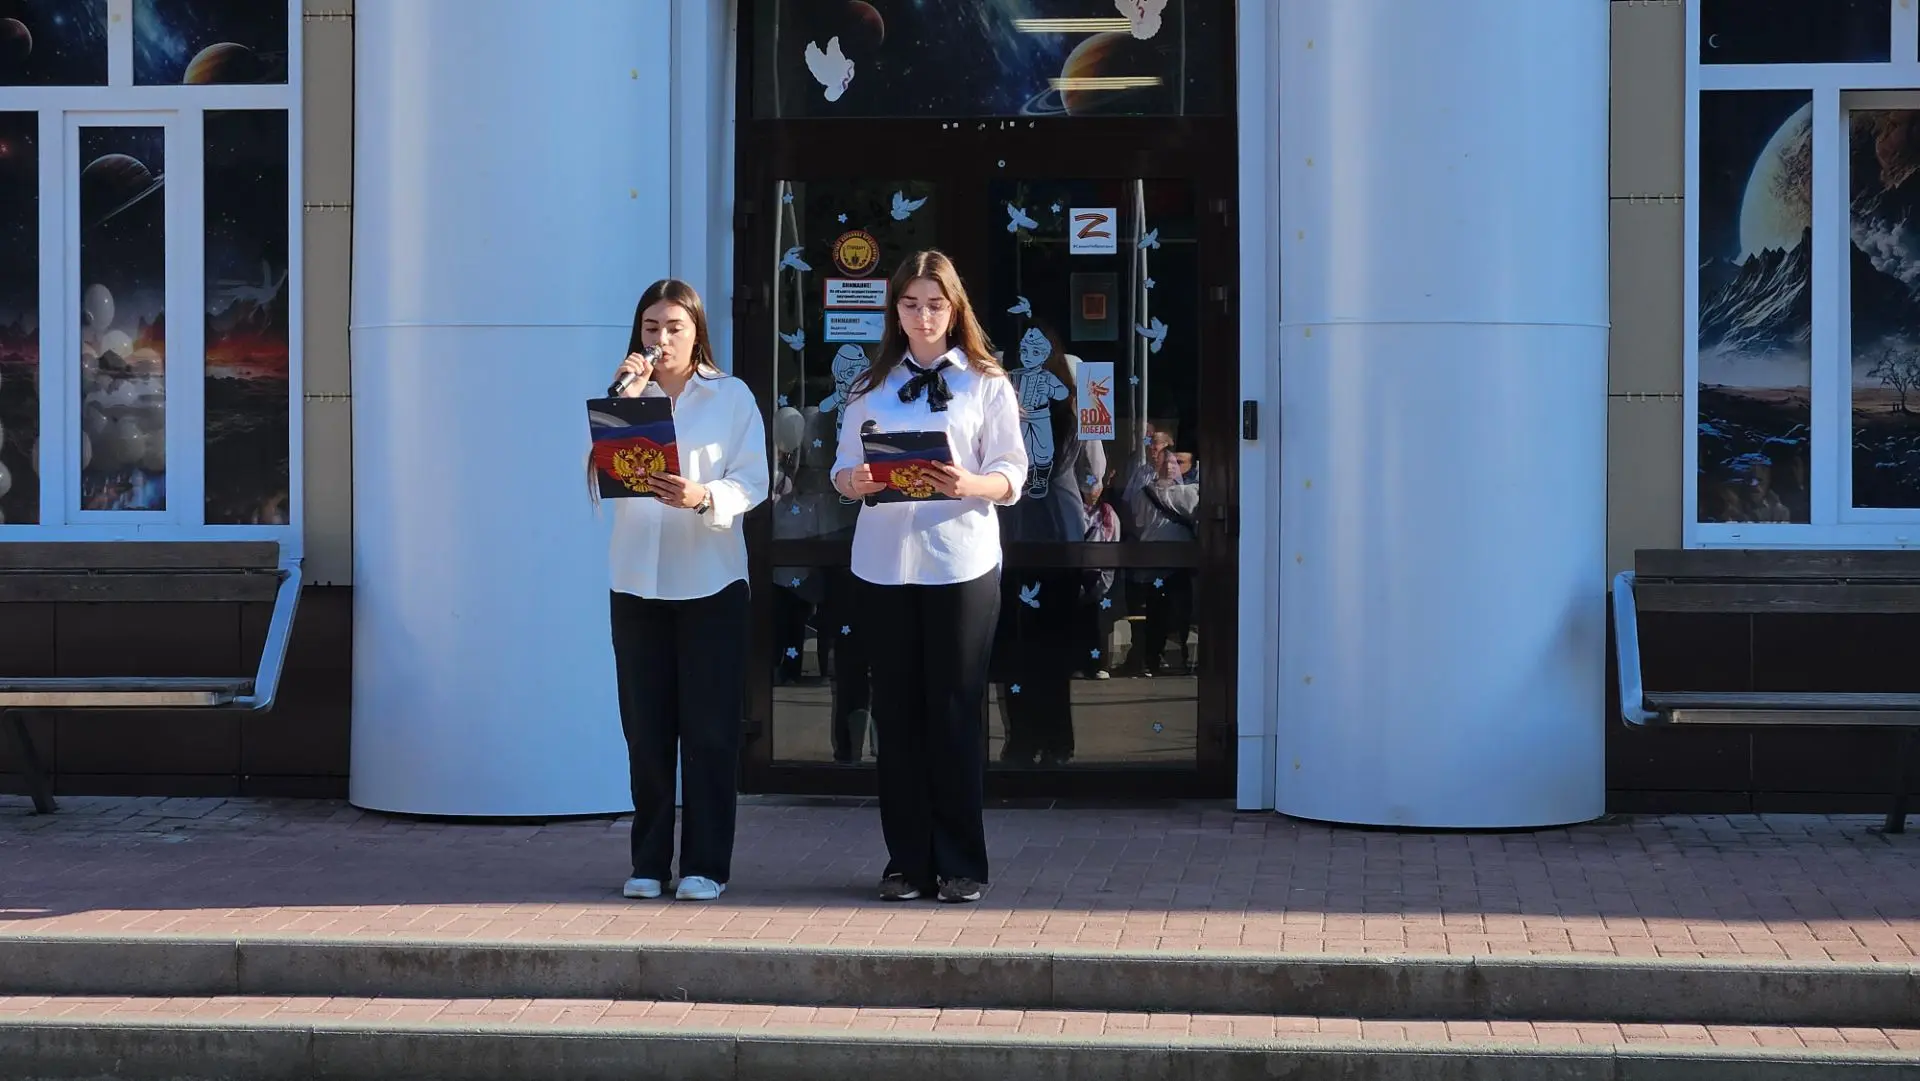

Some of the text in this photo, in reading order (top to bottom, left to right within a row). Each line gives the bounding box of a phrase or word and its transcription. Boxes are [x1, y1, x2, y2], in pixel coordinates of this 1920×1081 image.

[1074, 213, 1111, 239] Z
[1081, 408, 1098, 425] 80
[1081, 425, 1112, 434] ПОБЕДА!
